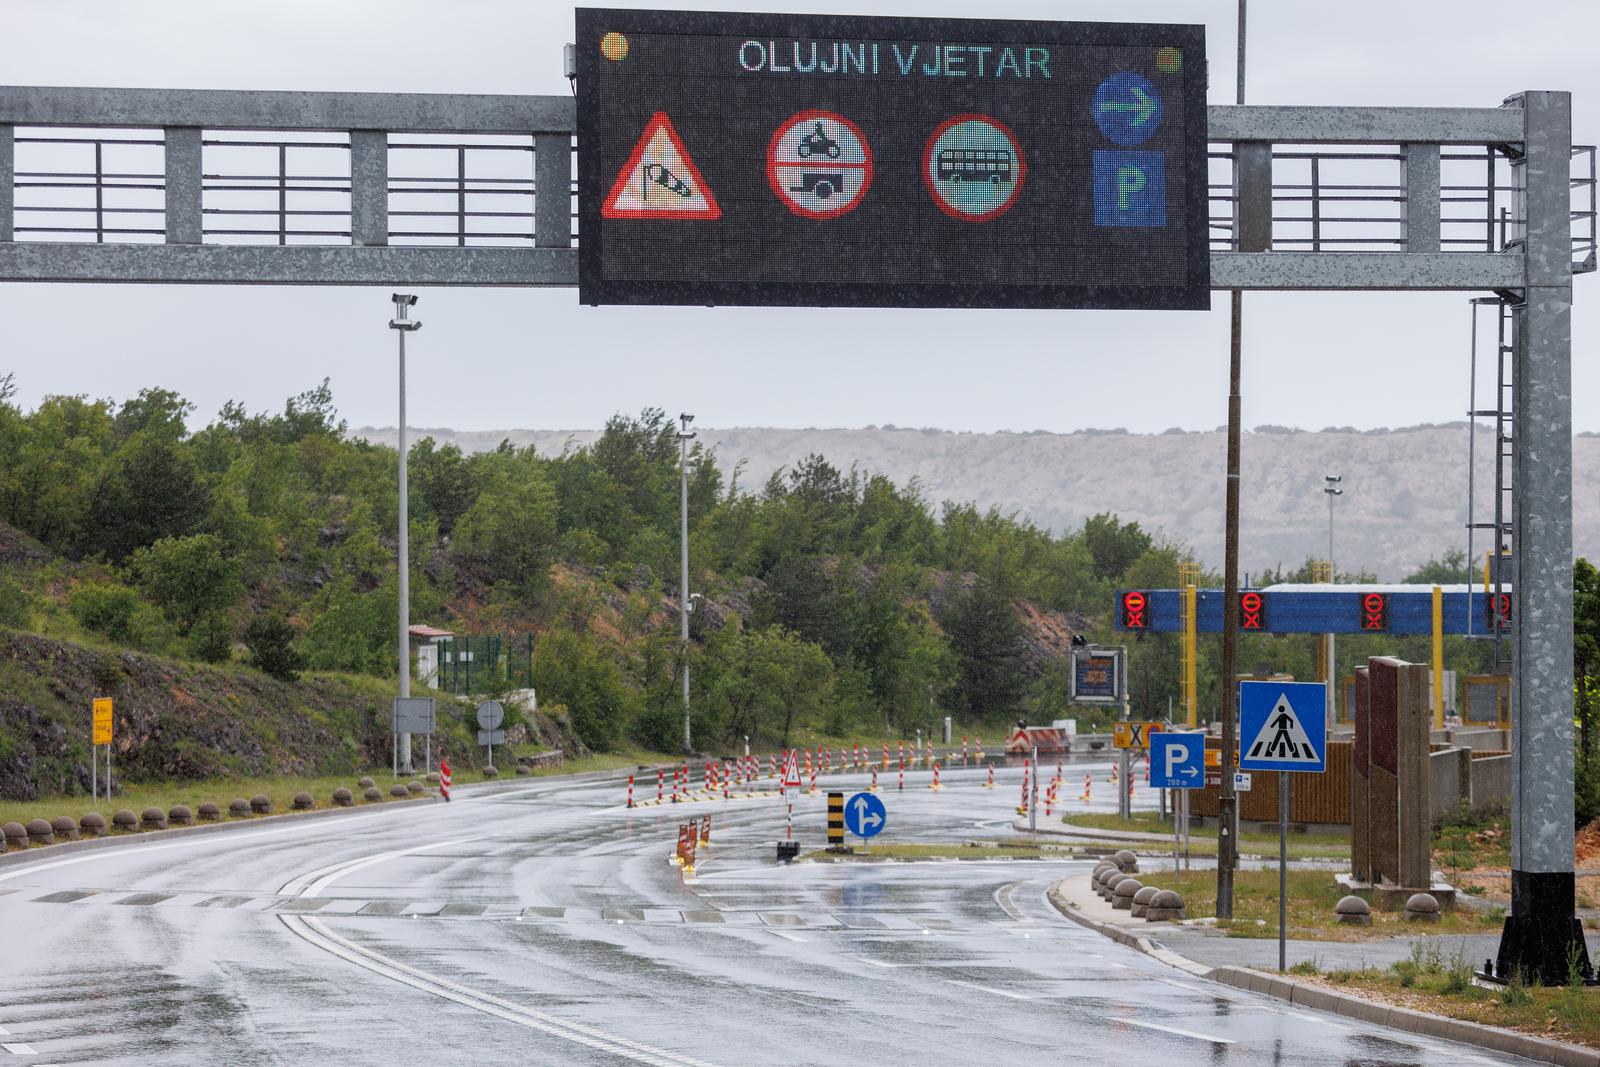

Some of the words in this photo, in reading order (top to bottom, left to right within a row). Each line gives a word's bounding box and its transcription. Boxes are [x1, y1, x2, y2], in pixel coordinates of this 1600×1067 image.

[739, 40, 878, 75] OLUJNI
[892, 44, 1052, 79] VJETAR
[1118, 162, 1148, 210] P
[1165, 743, 1189, 778] P
